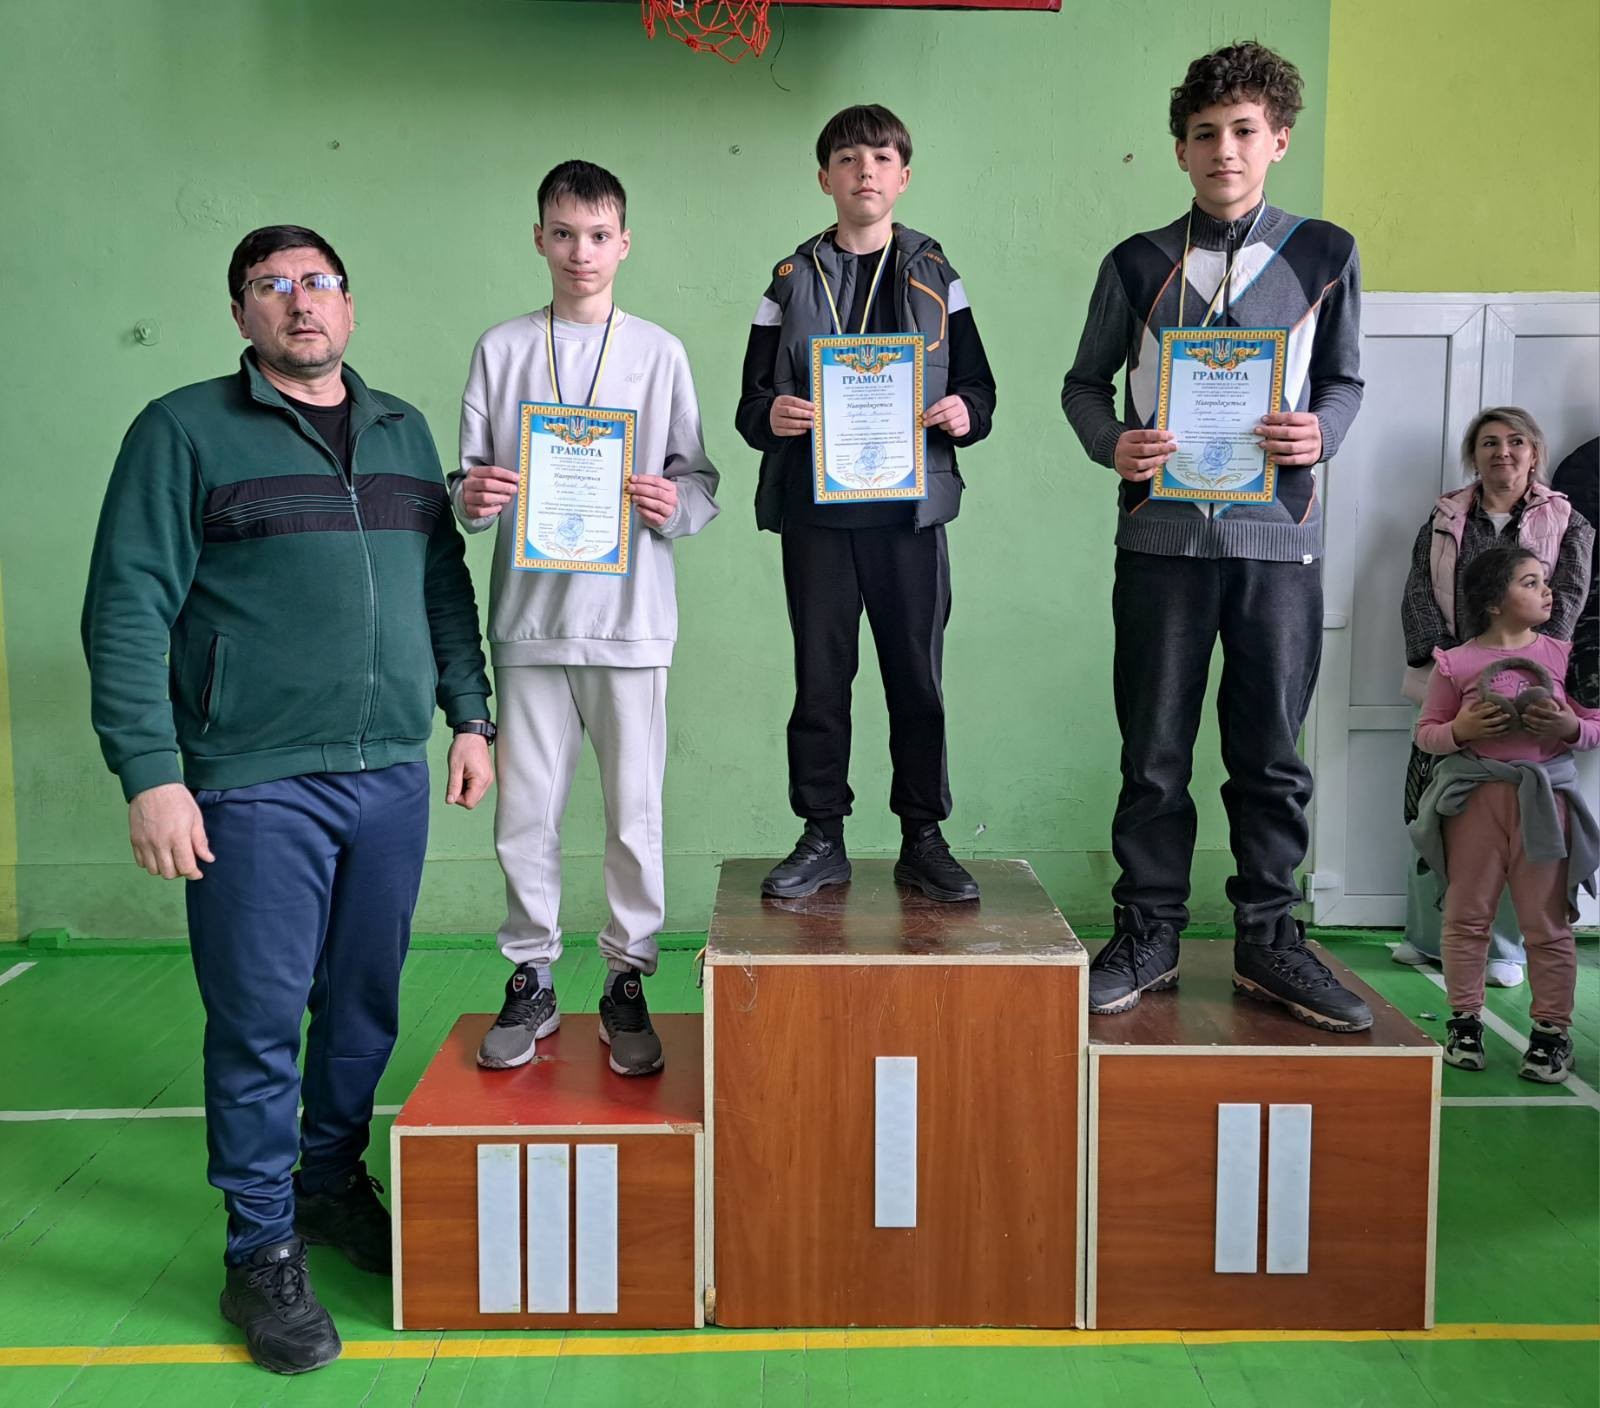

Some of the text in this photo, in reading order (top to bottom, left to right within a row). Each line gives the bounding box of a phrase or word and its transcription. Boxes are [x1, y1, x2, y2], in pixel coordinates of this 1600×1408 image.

[841, 374, 894, 385] ГРАМОТА
[1192, 371, 1249, 381] ГРАМОТА
[1195, 399, 1247, 408] Нагороджується
[550, 445, 603, 457] ГРАМОТА
[553, 472, 601, 482] Нагороджується
[1215, 1103, 1312, 1274] II
[477, 1143, 619, 1314] III
